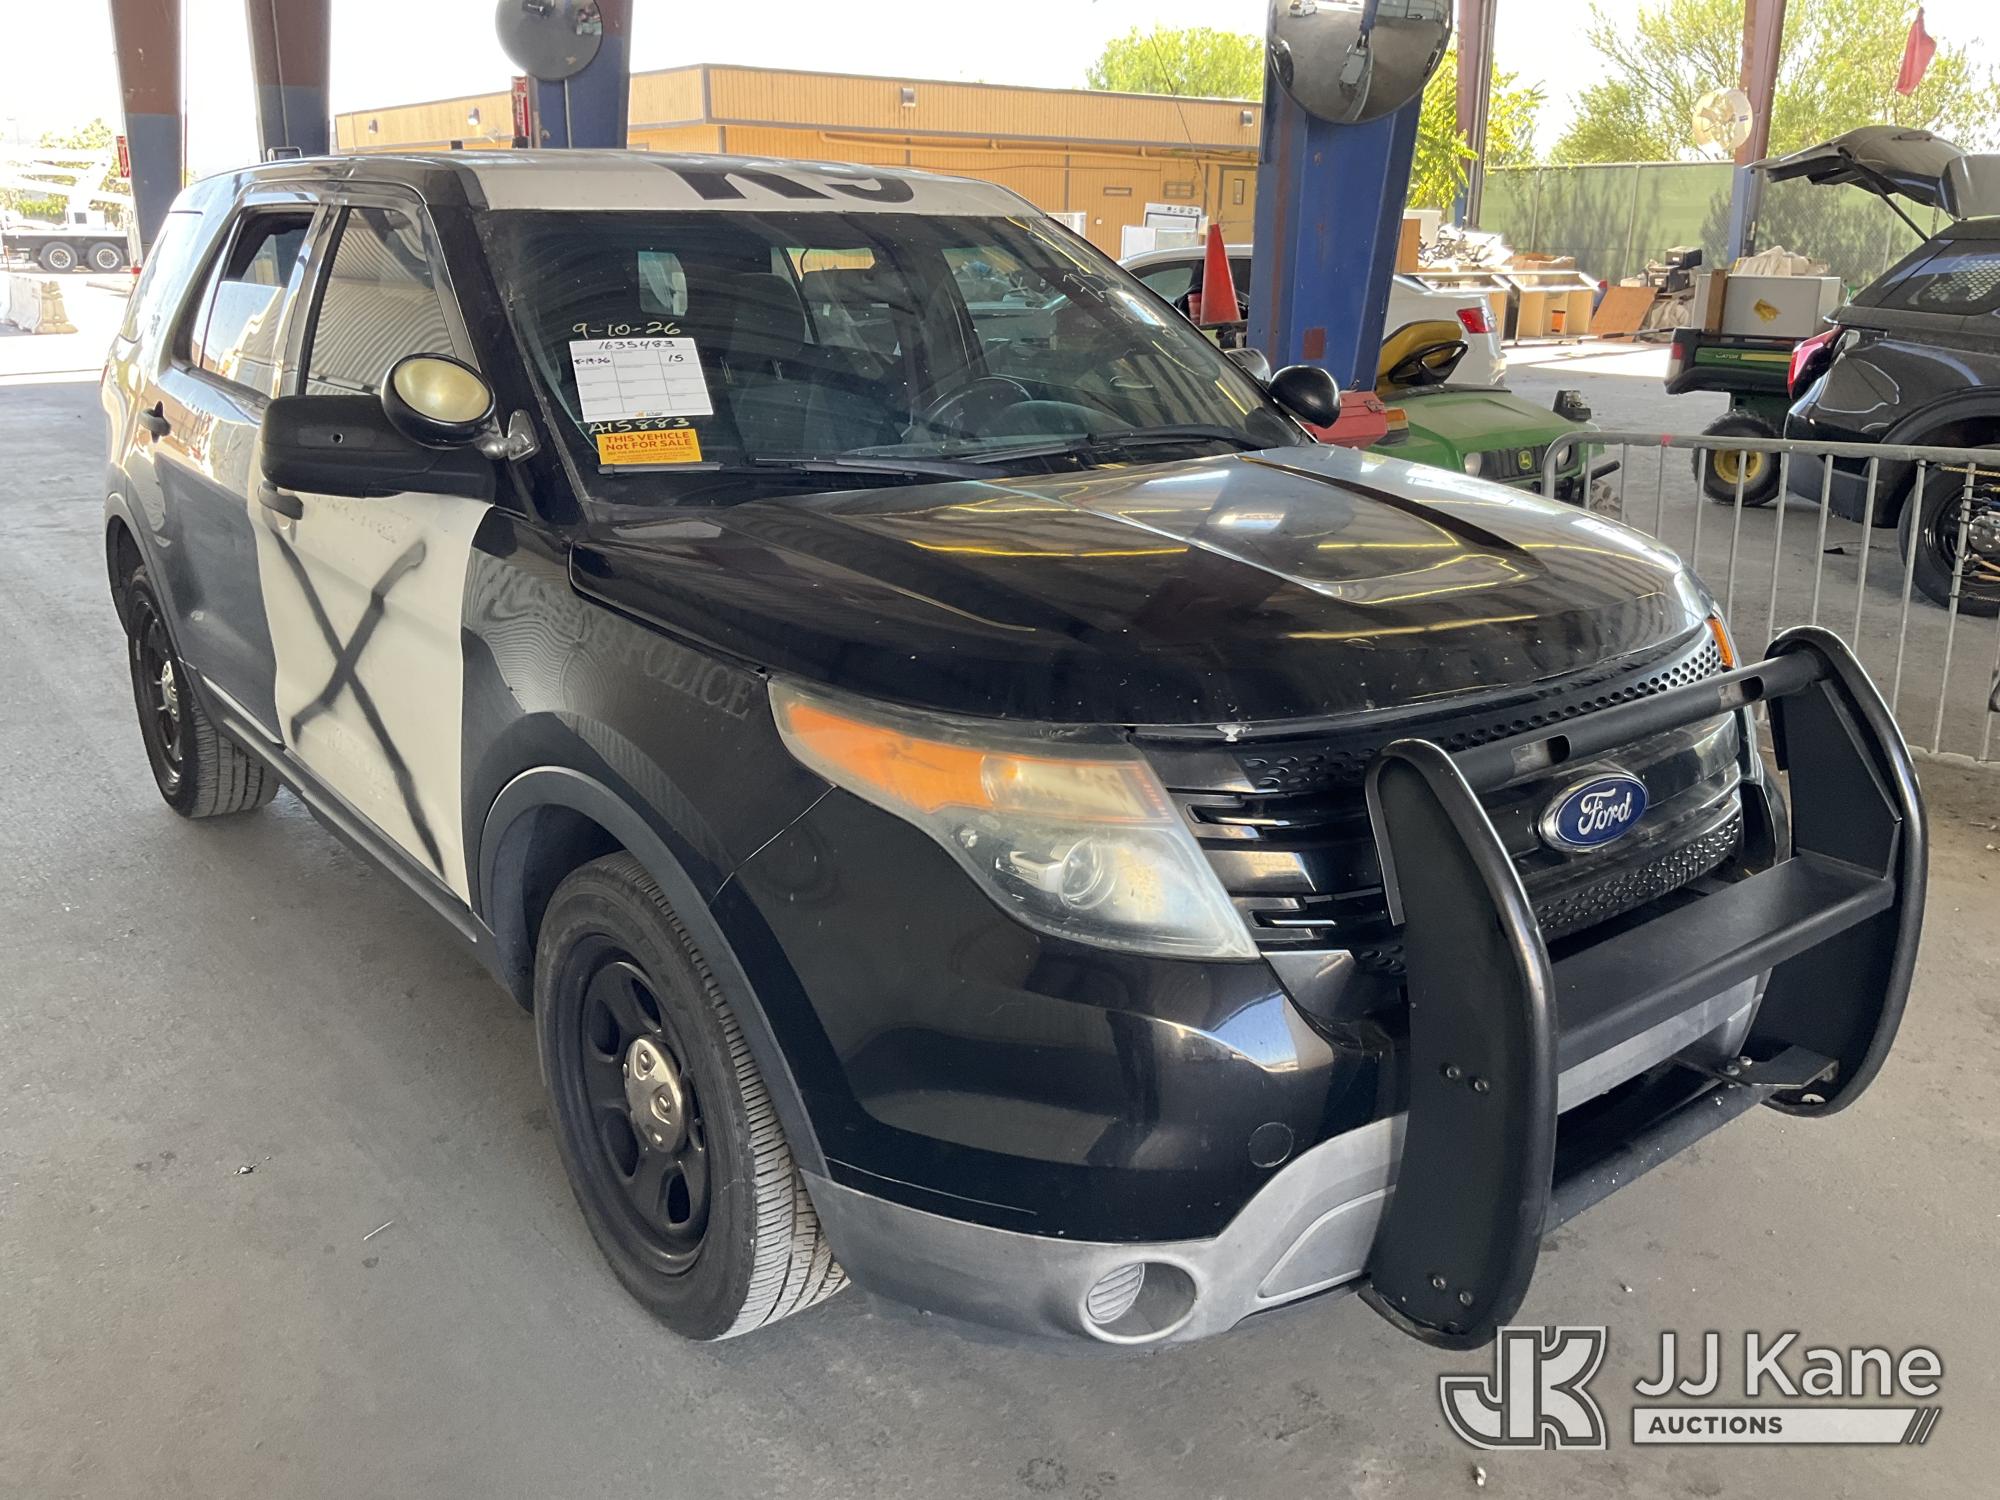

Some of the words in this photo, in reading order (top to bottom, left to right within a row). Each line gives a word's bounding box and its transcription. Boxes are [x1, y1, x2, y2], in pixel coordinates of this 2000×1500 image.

[572, 321, 681, 339] 9-10-26
[599, 340, 675, 350] 1635483
[668, 354, 685, 363] 15
[606, 434, 634, 444] THIS
[636, 431, 690, 441] VEHICLE
[632, 441, 657, 449] FOR
[660, 439, 692, 447] SALE
[1577, 787, 1634, 836] Ford
